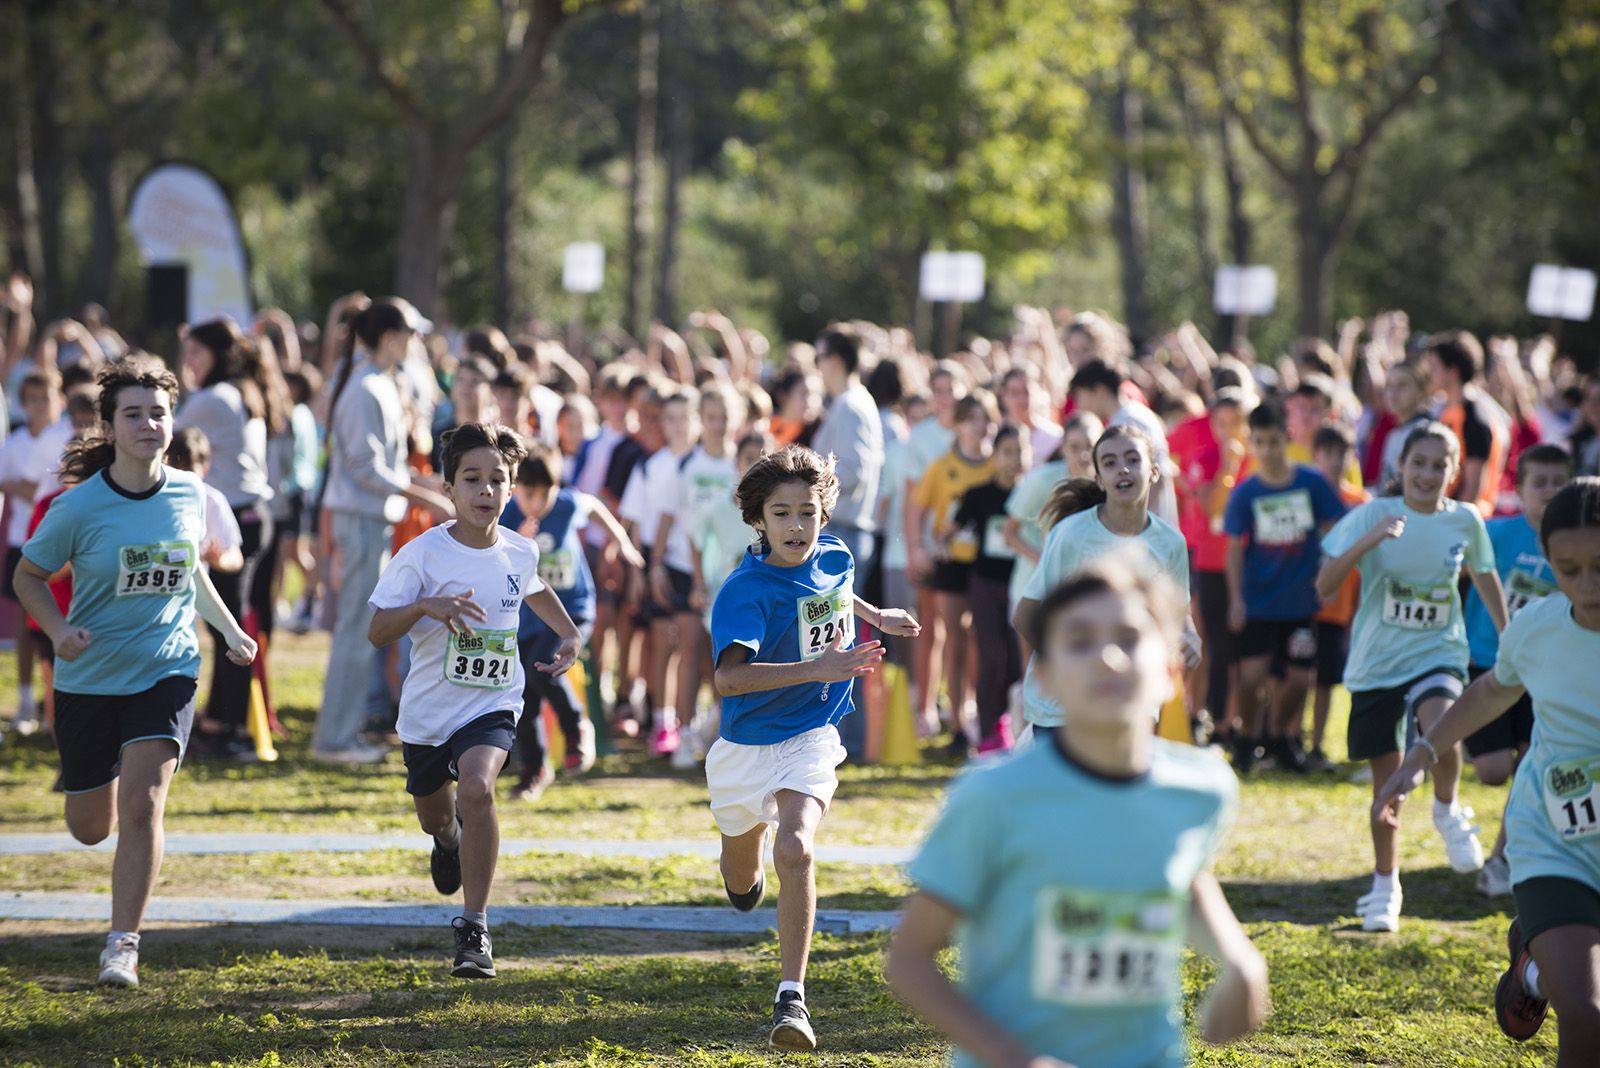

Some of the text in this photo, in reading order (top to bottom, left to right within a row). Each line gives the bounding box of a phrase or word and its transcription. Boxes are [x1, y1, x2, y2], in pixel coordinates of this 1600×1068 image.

[127, 569, 179, 587] 1395
[807, 601, 830, 621] CROS
[1394, 602, 1438, 622] 1143
[458, 637, 483, 649] CROS
[455, 656, 509, 679] 3924
